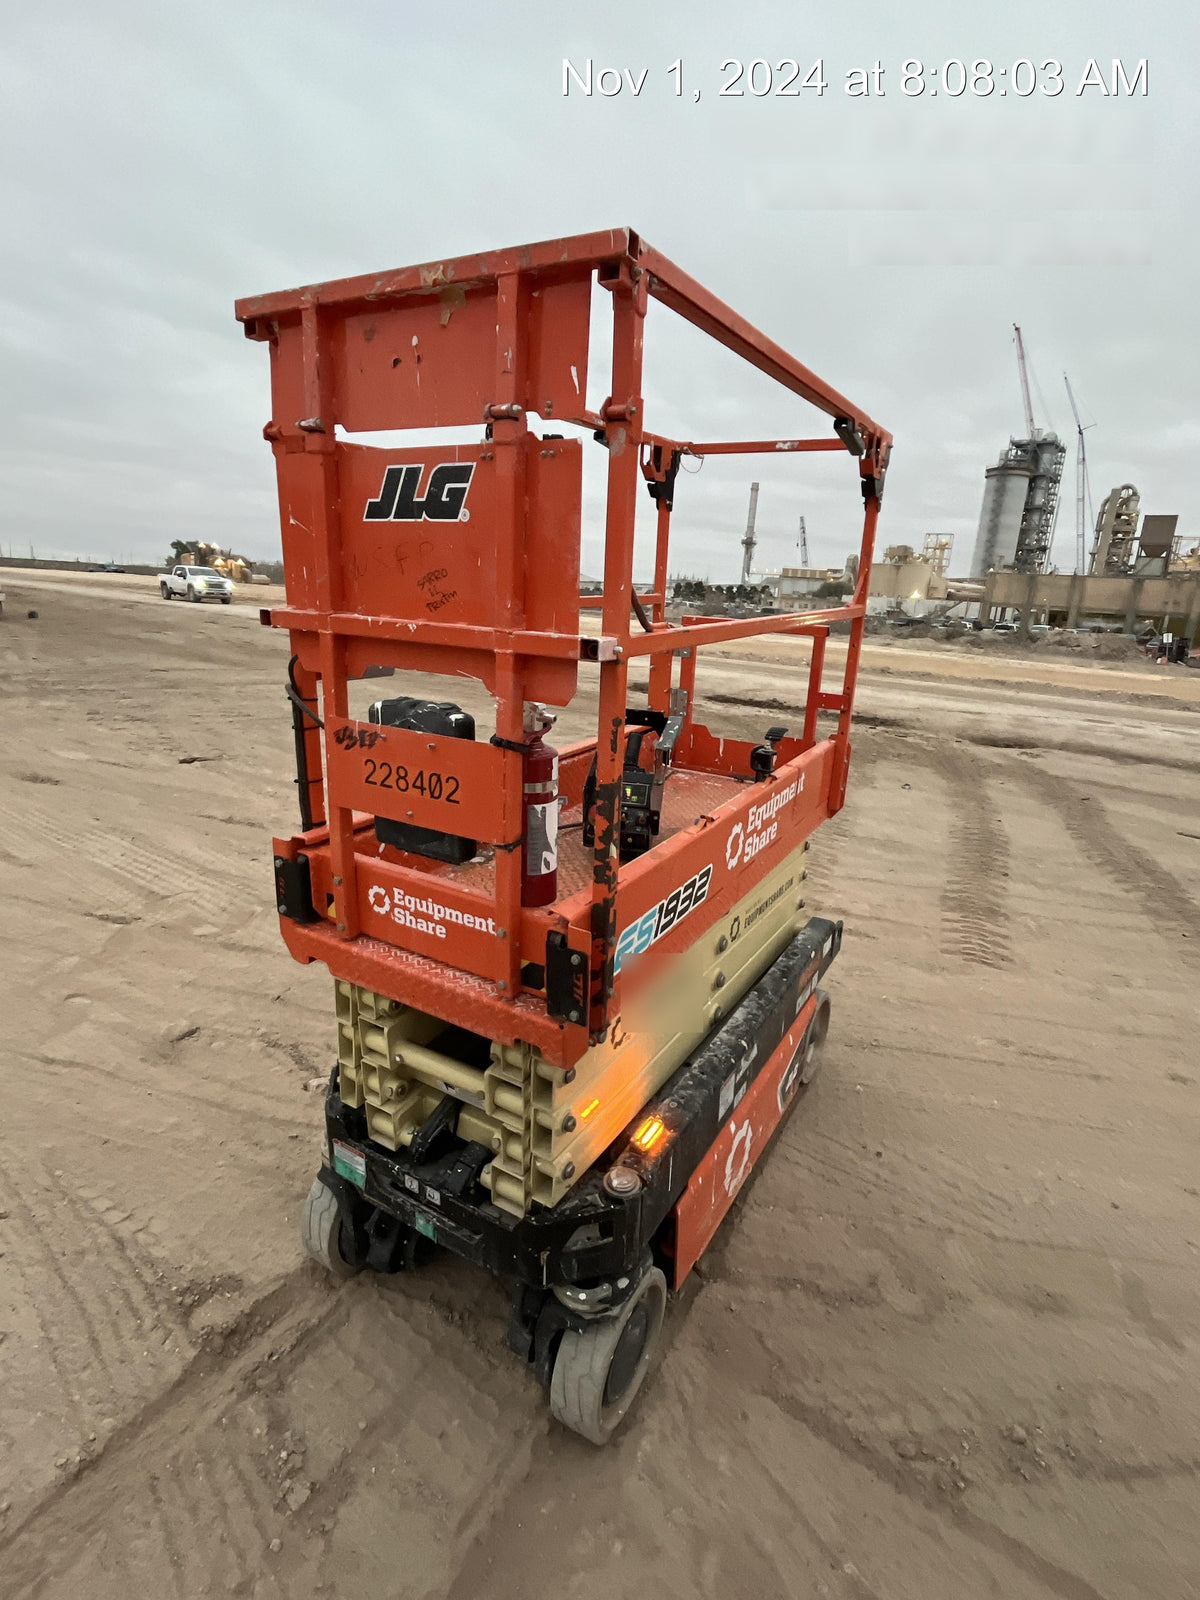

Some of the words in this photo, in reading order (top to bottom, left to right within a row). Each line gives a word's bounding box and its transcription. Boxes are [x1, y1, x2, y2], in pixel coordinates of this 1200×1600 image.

[363, 461, 476, 522] JLG
[364, 759, 460, 805] 228402
[746, 772, 805, 833] Equipment
[744, 821, 778, 863] Share
[391, 907, 447, 939] Share
[392, 887, 497, 936] Equipment
[614, 863, 713, 976] ES1932
